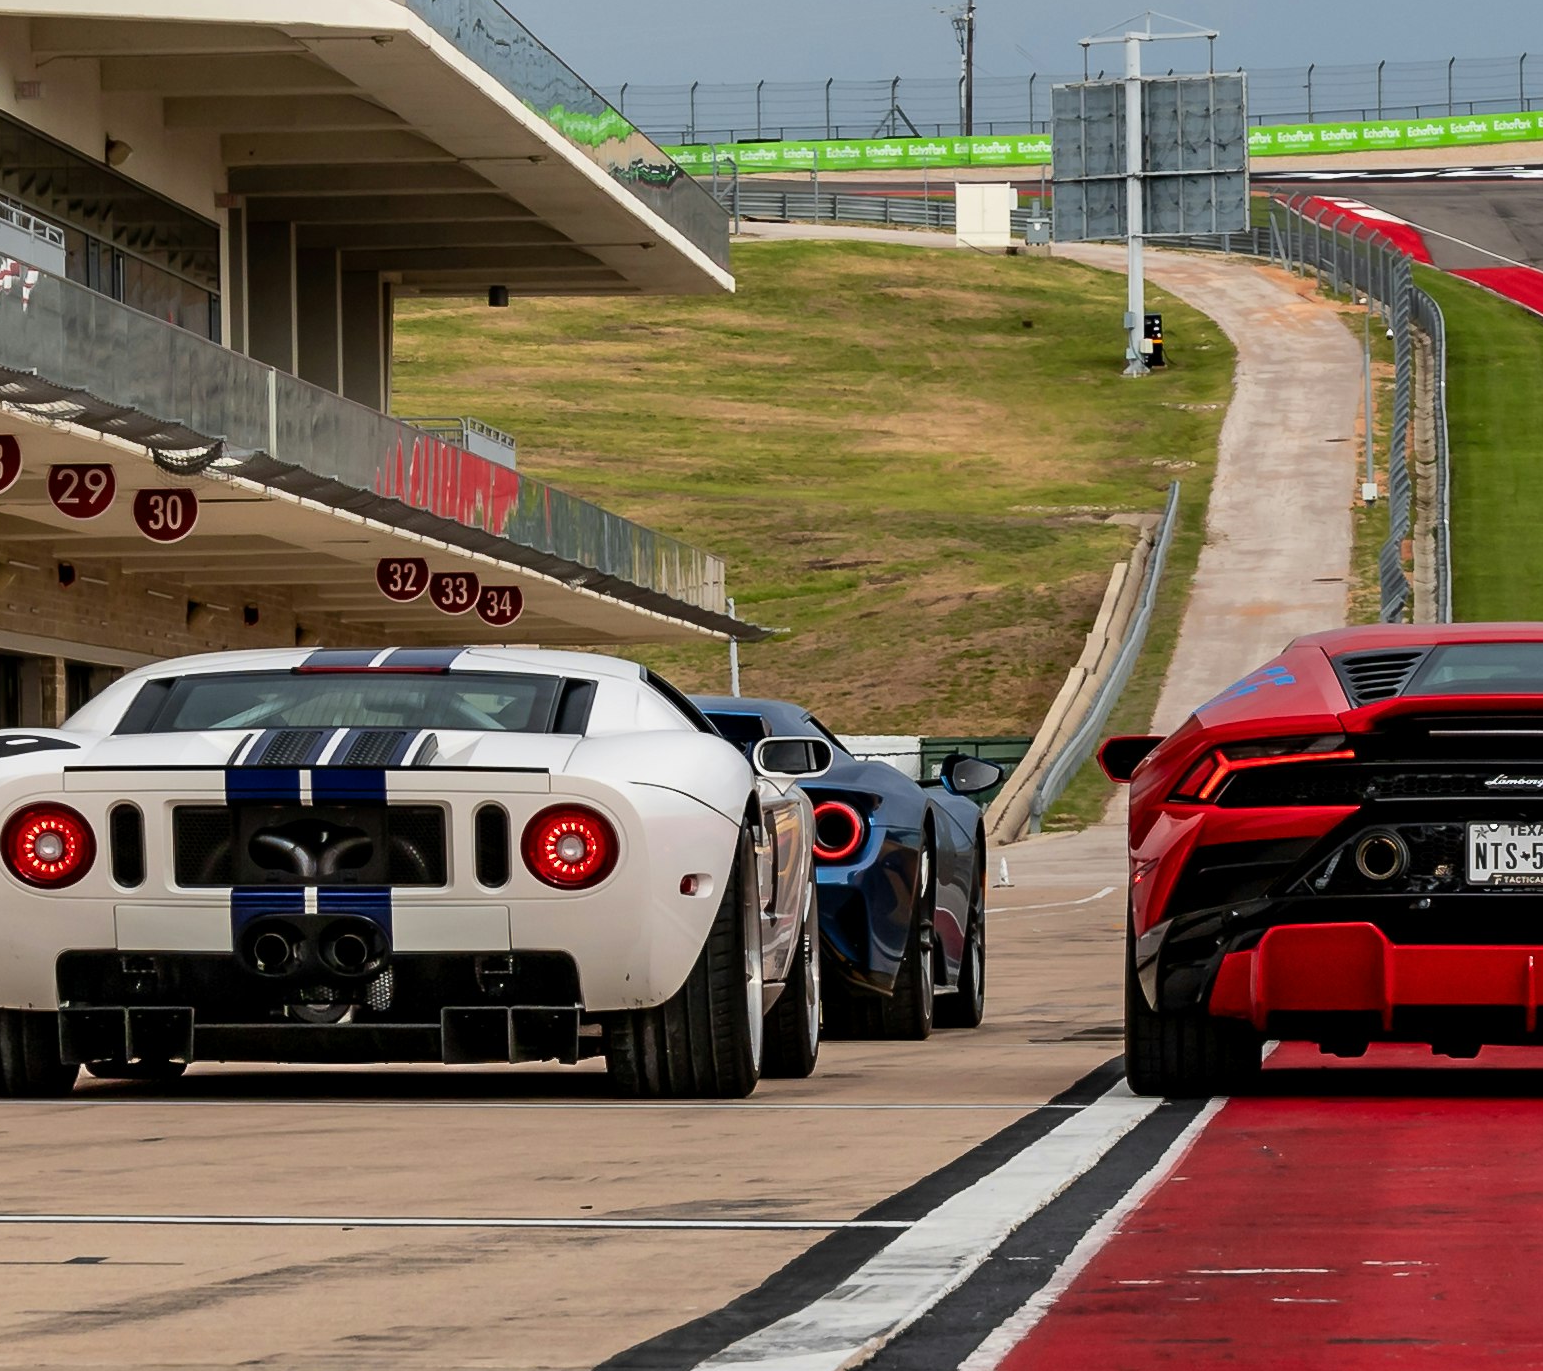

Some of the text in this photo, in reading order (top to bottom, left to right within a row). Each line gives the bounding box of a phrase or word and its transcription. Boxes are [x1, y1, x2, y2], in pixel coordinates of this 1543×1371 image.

[1407, 124, 1445, 137] EchoPark
[1450, 120, 1488, 133] EchoPark
[1493, 117, 1532, 131] EchoPark
[1277, 130, 1315, 143] EchoPark
[1320, 128, 1358, 141] EchoPark
[1363, 126, 1401, 139] EchoPark
[972, 141, 1012, 153] EchoPark
[57, 469, 108, 505] 29
[149, 496, 183, 531] 30
[388, 563, 417, 592] 32
[441, 578, 468, 606] 33
[485, 591, 513, 618] 34
